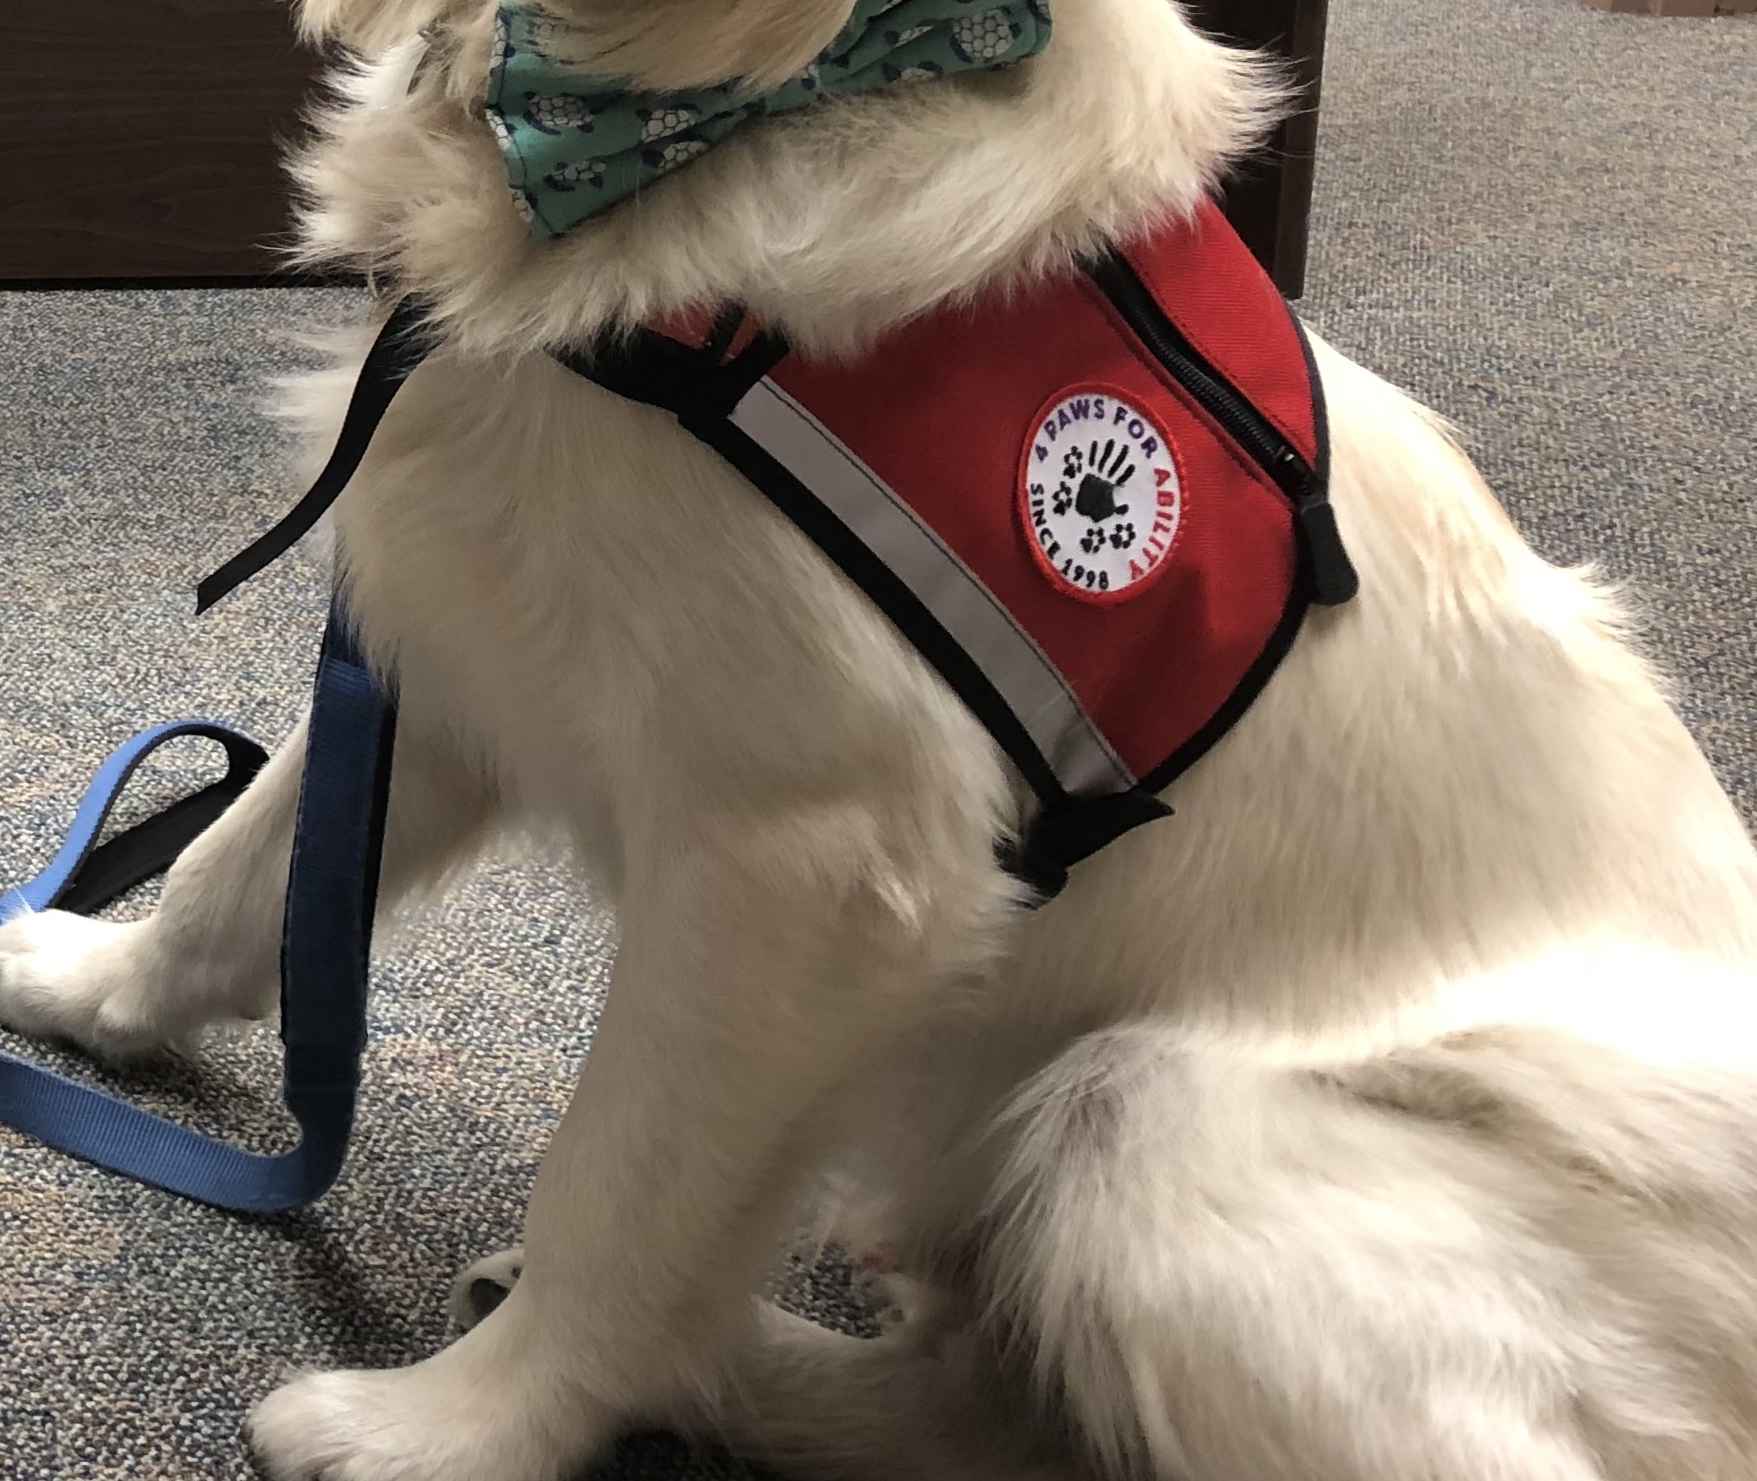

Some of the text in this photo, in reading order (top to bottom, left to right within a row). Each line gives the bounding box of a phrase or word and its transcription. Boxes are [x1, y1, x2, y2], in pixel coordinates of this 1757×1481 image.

[1029, 483, 1110, 591] SINCE 1998
[1034, 398, 1176, 582] 4 PAWS FOR ABILITY
